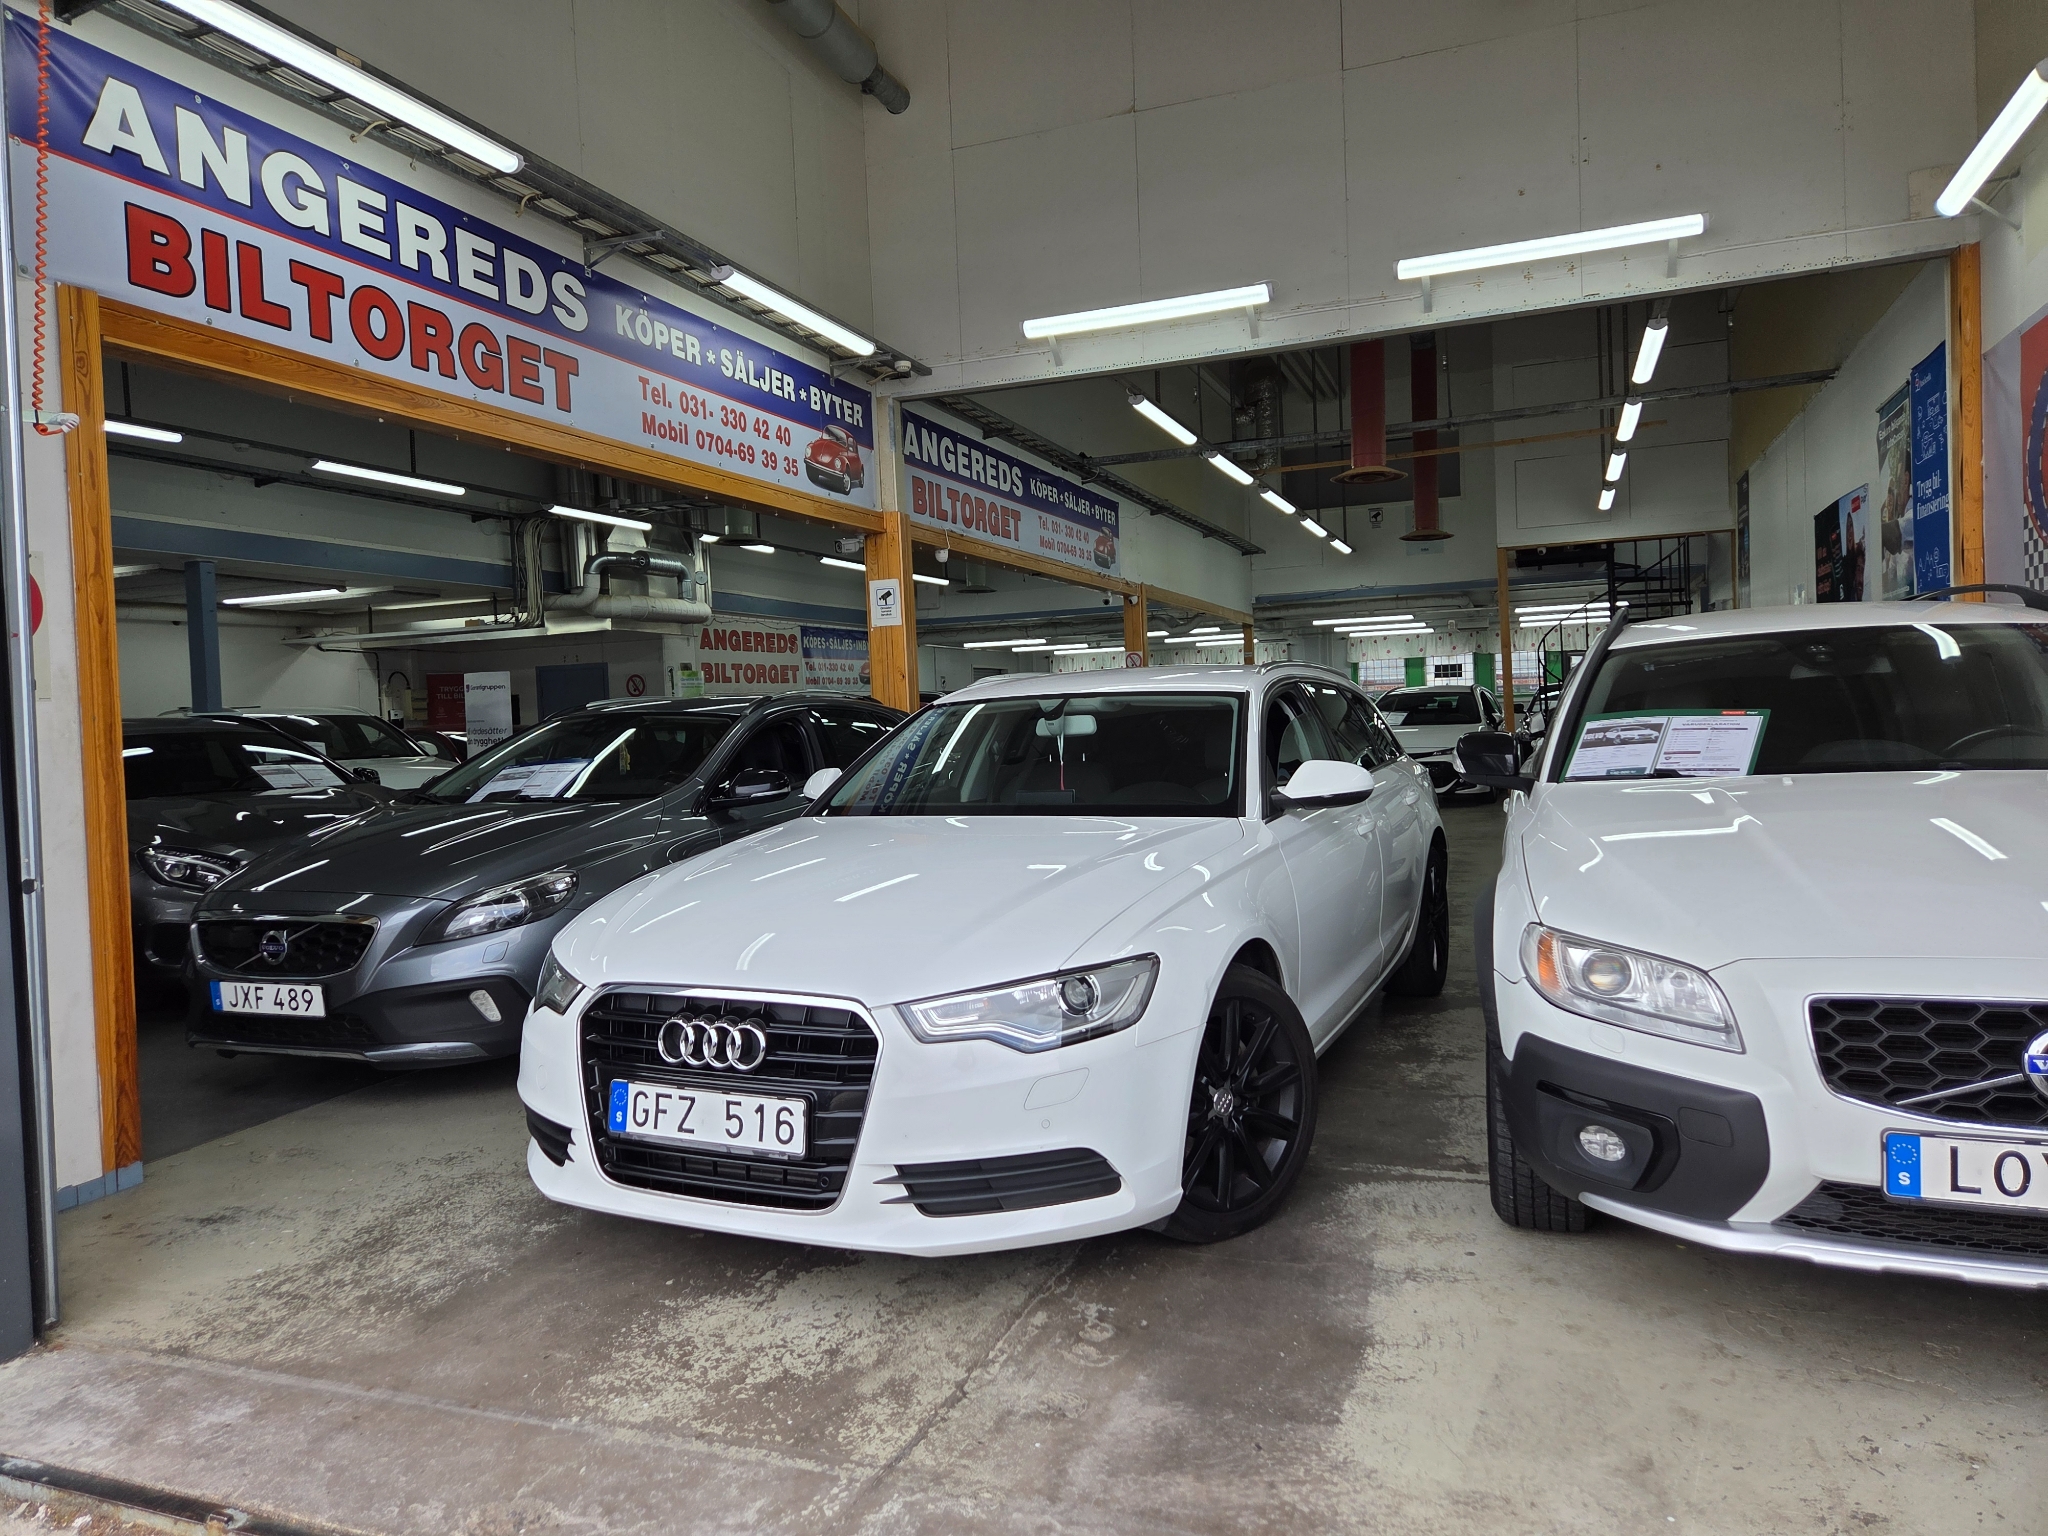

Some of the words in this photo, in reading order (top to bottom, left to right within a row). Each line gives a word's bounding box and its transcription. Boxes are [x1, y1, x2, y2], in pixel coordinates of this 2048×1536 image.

[82, 76, 589, 333] ANGEREDS
[615, 303, 702, 366] KÖPER
[720, 348, 796, 402] SÄLJER
[809, 385, 863, 428] BYTER
[124, 200, 579, 414] BILTORGET
[638, 375, 673, 409] Tel.
[679, 391, 714, 420] 031-
[720, 405, 747, 433] 330
[753, 416, 770, 440] 42
[775, 424, 791, 447] 40
[641, 411, 689, 446] Mobil
[695, 429, 755, 464] 0704-69
[761, 449, 778, 470] 39
[783, 455, 799, 477] 35
[903, 421, 1024, 498] ANGEREDS
[1029, 478, 1059, 505] KÖPER
[1064, 492, 1091, 517] SÄLJER
[1094, 504, 1116, 526] BYTER
[1917, 479, 1932, 500] Trygg
[911, 475, 1022, 542] BILTORGET
[1038, 515, 1050, 532] Tel.
[1065, 524, 1075, 540] 330
[1076, 528, 1082, 542] 42
[1083, 531, 1090, 545] 40
[1040, 535, 1056, 551] Mobil
[1079, 547, 1085, 560] 39
[1086, 549, 1092, 562] 35
[700, 627, 799, 654] ANGEREDS
[803, 634, 826, 650] KÖPES
[829, 636, 853, 651] SÄLJES
[701, 662, 800, 685] BILTORGET
[805, 661, 816, 671] Tel.
[840, 663, 847, 672] 42
[848, 663, 855, 673] 40
[805, 676, 820, 685] Mobil
[853, 677, 859, 685] 35
[229, 985, 264, 1010] JXF
[273, 987, 314, 1013] 489
[615, 1111, 623, 1123] S
[632, 1090, 696, 1135] GFZ
[724, 1099, 795, 1145] 516
[1898, 1171, 1911, 1186] S
